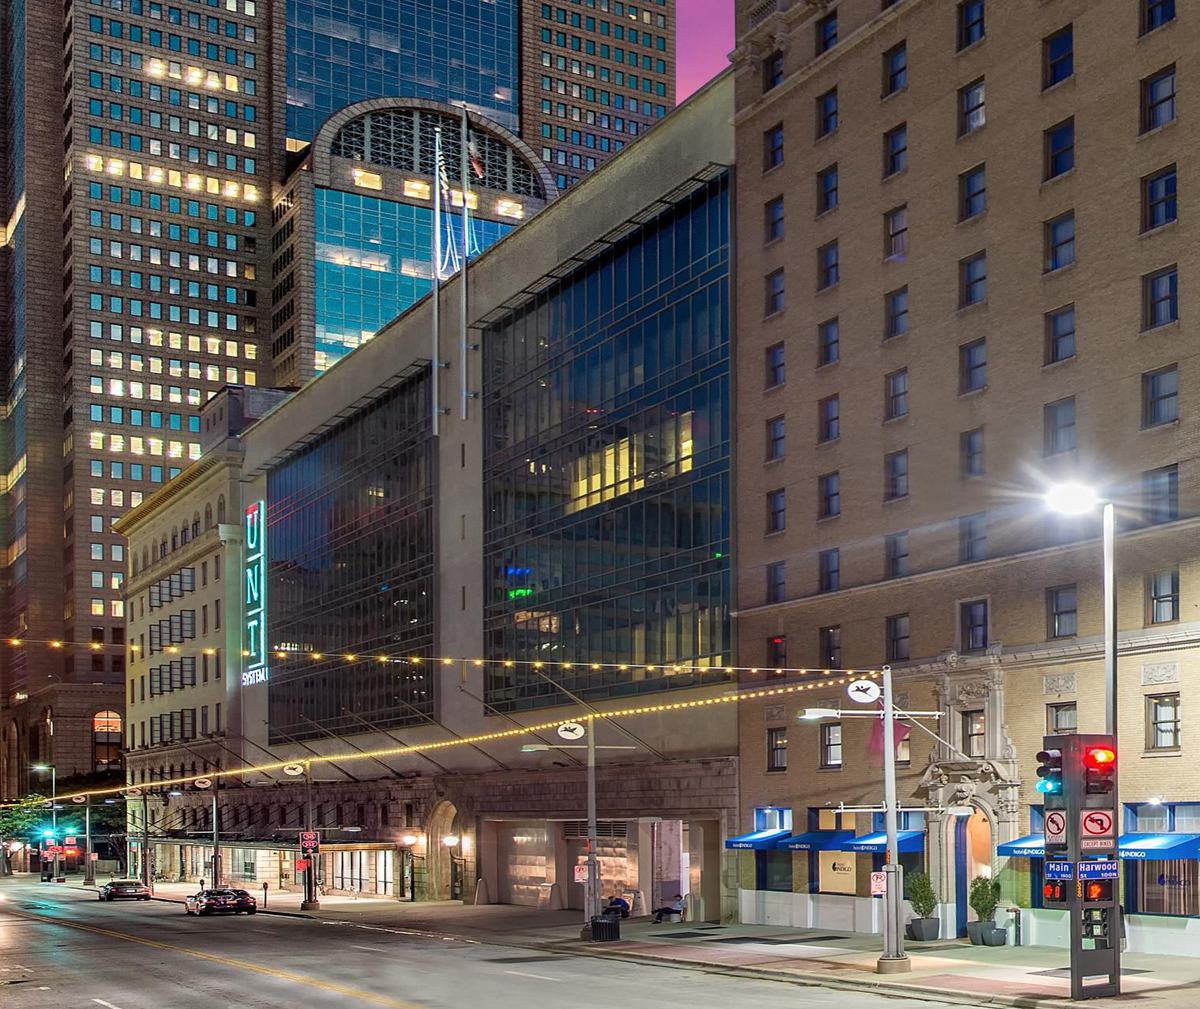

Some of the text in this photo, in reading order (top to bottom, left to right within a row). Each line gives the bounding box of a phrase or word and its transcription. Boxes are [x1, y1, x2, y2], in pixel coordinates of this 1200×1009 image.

[246, 510, 259, 657] UNT
[1049, 863, 1069, 872] Main
[1080, 862, 1117, 872] Harwood
